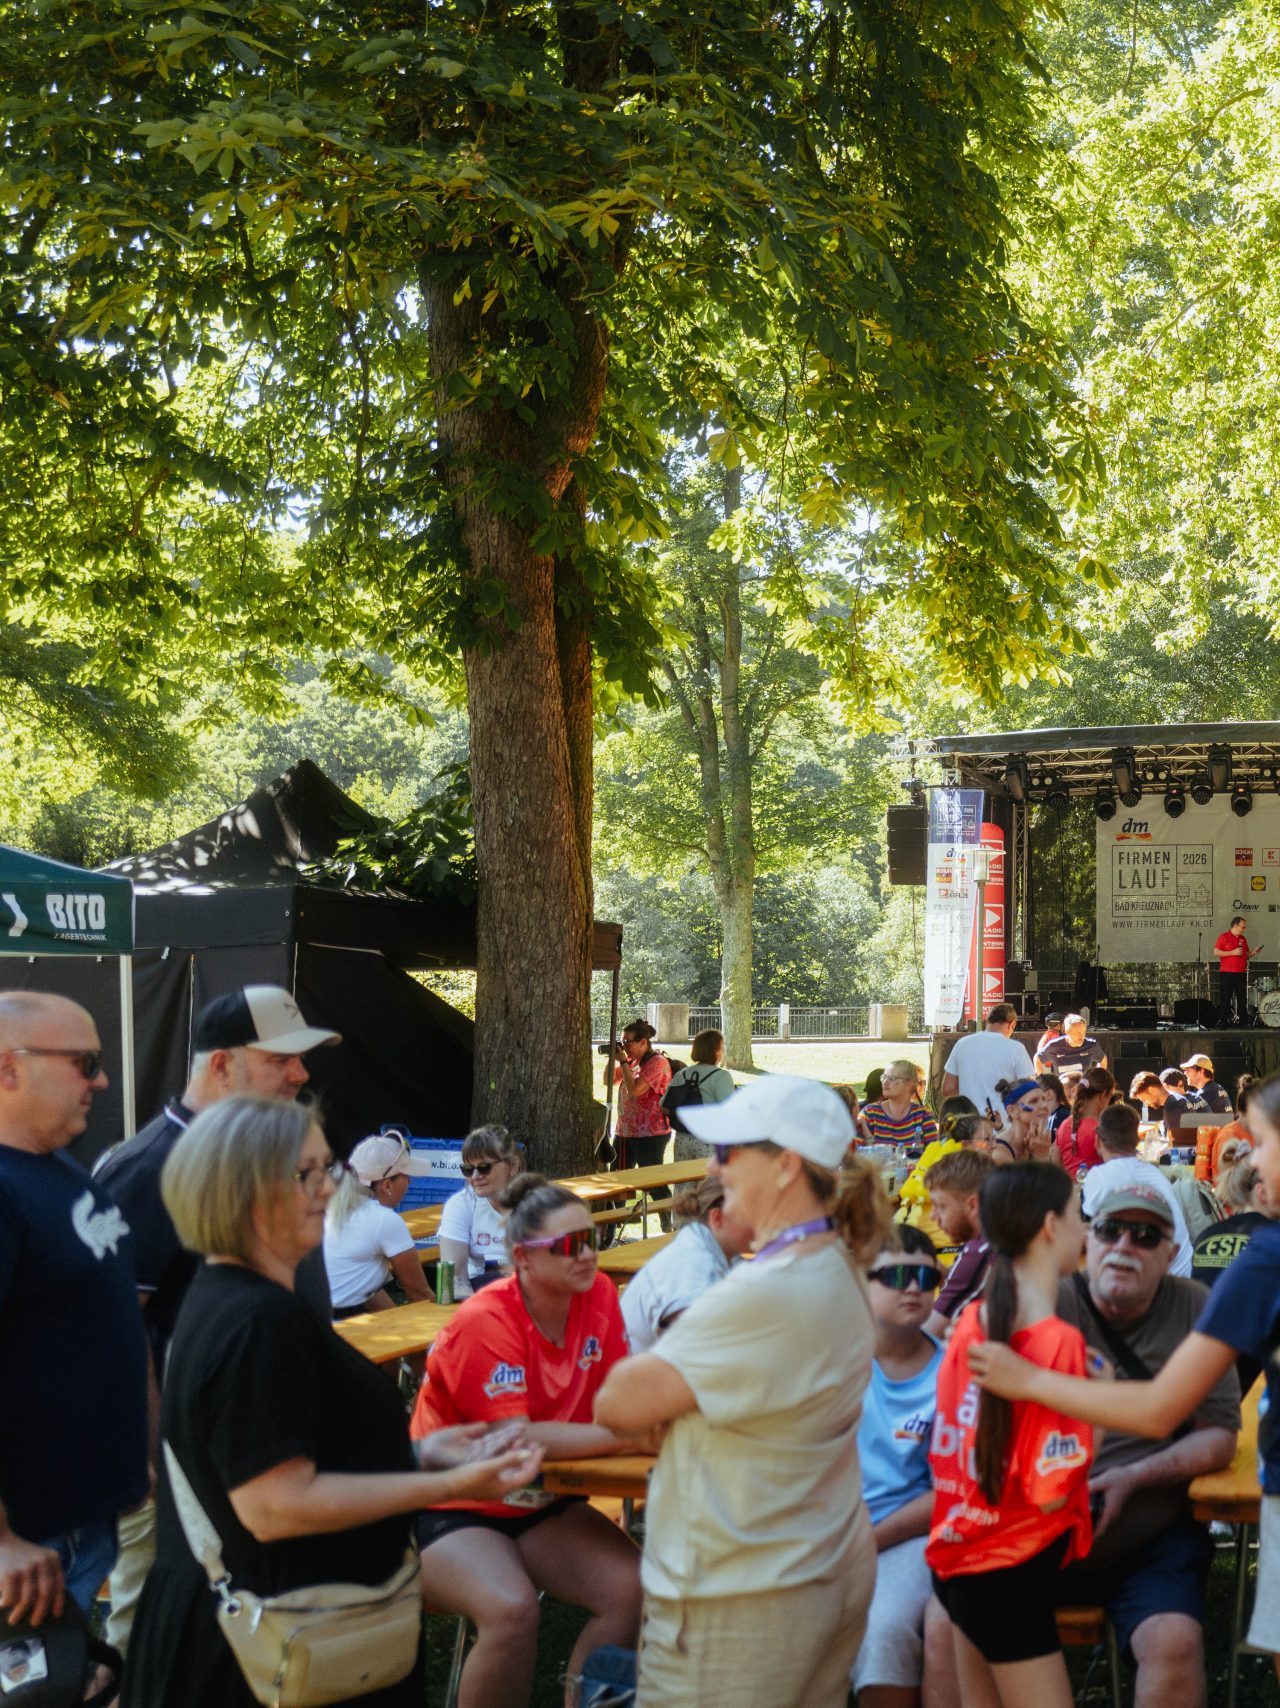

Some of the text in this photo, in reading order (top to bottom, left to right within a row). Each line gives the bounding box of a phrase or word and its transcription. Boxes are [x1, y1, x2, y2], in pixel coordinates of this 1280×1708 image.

[1121, 817, 1149, 833] dm
[1118, 851, 1171, 865] FIRMEN
[1183, 853, 1207, 865] 2026
[1118, 868, 1170, 889] LAUF
[46, 894, 106, 930] BITO
[1114, 901, 1174, 911] BAD KREUZNACH
[1112, 919, 1214, 929] WWW.FIRMENLAUF-KH.DE
[54, 933, 107, 941] LAGERTECHNIK
[495, 1365, 523, 1384] dm
[1044, 1433, 1077, 1457] dm
